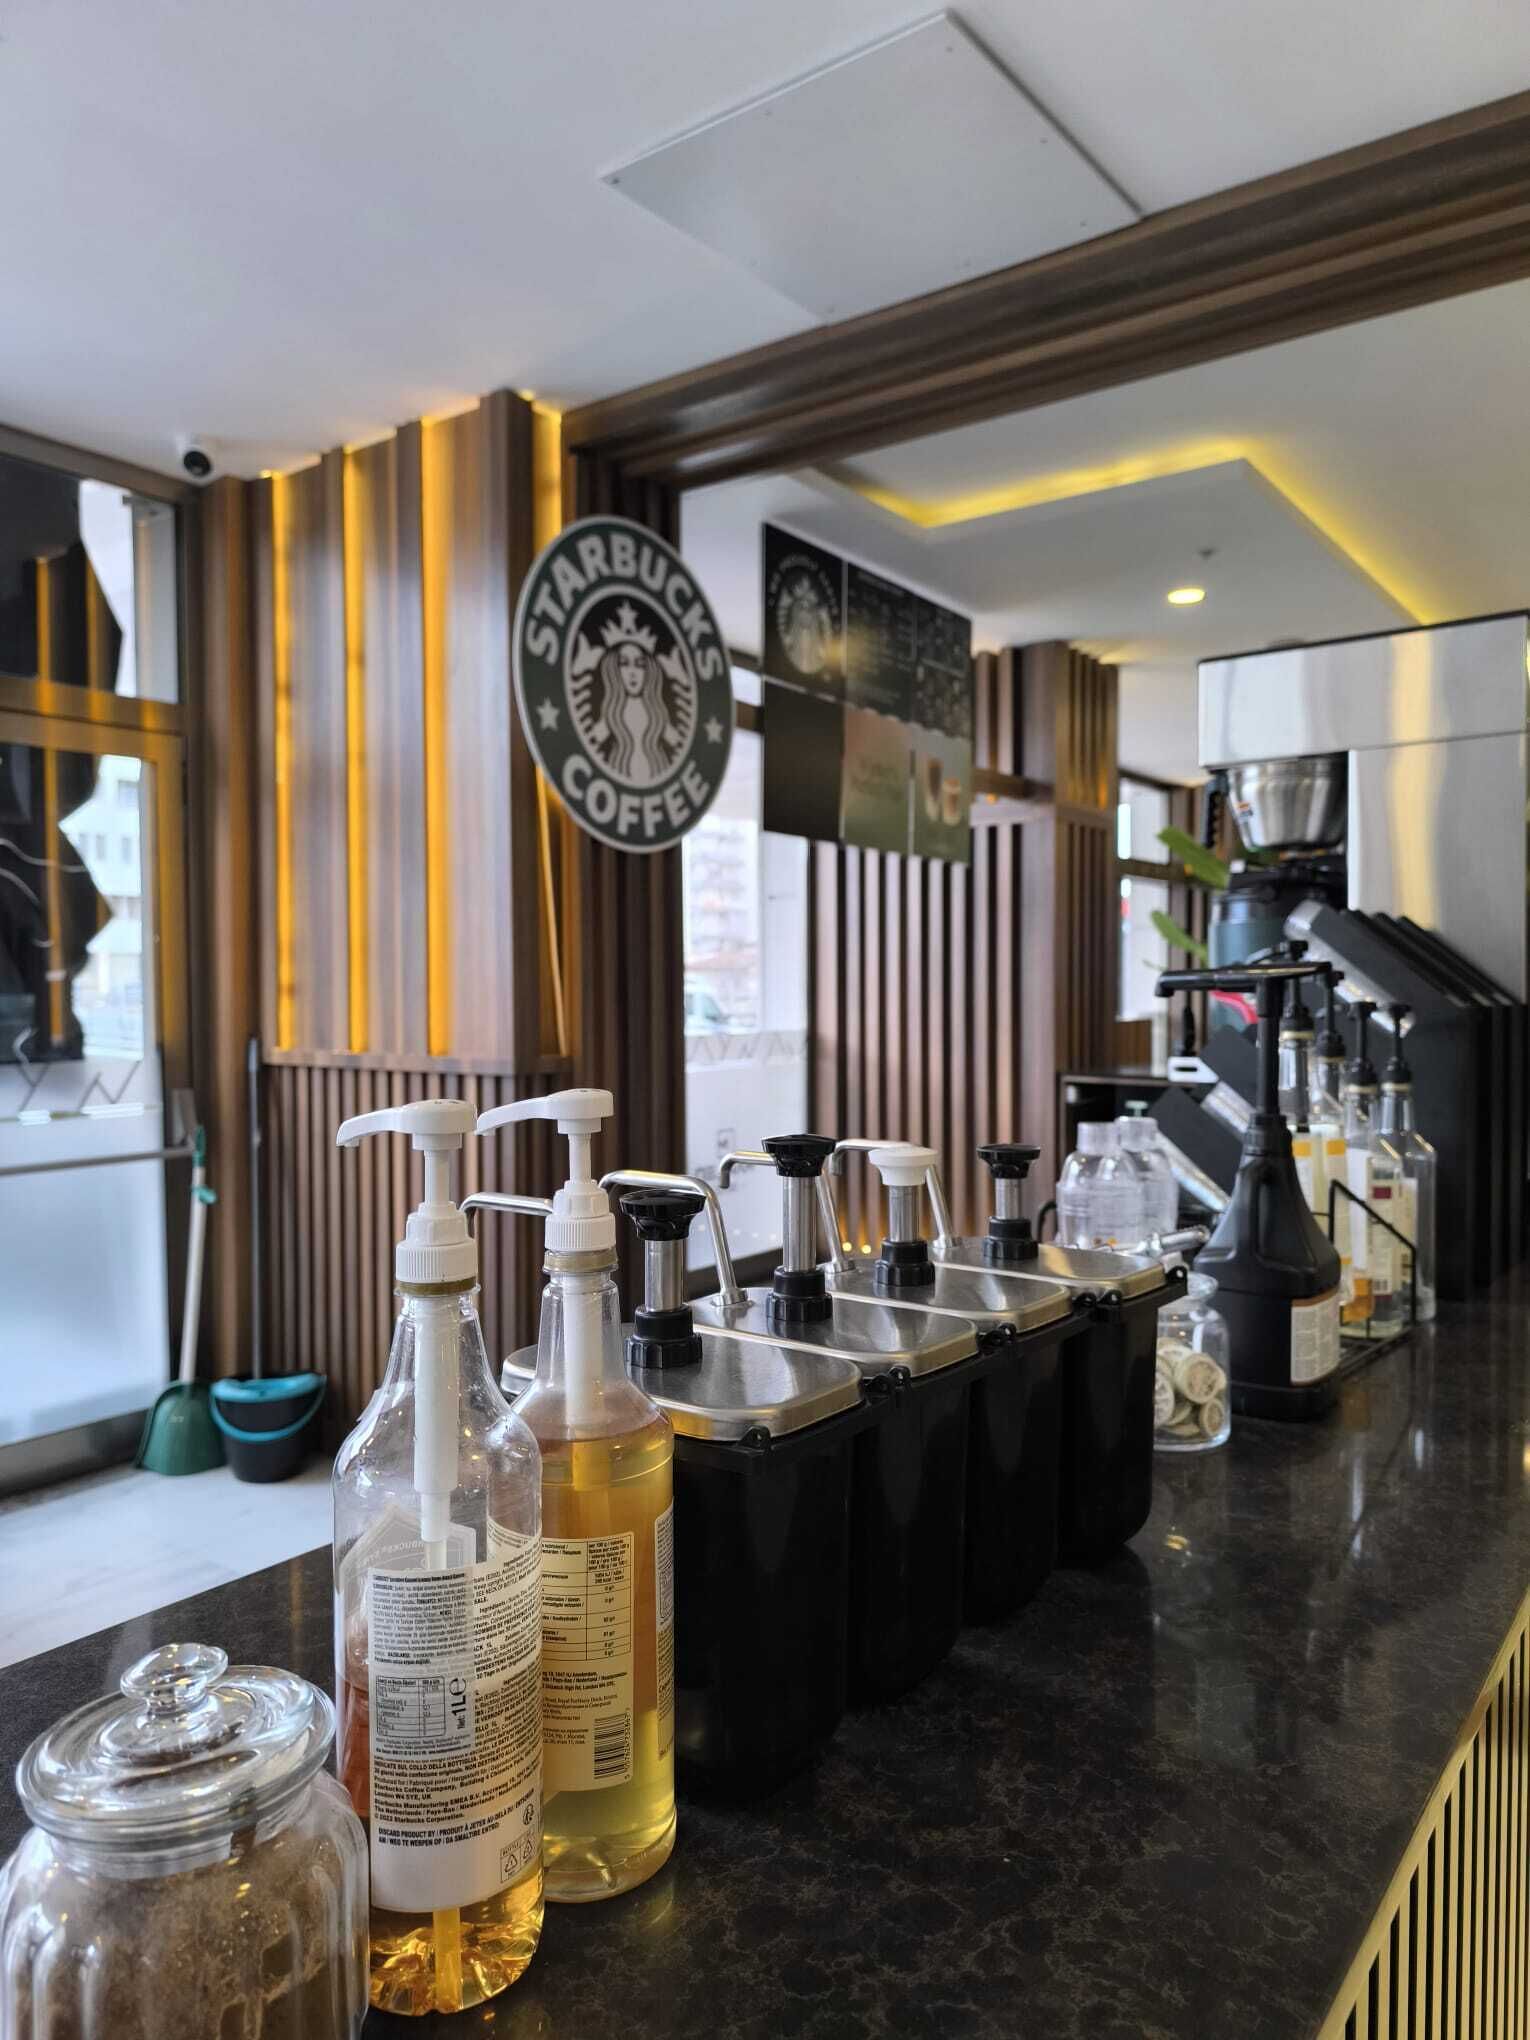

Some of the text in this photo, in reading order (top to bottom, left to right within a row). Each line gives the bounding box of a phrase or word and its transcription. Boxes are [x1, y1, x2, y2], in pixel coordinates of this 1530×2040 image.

[526, 532, 724, 681] STARBUCKS
[562, 753, 711, 838] COFFEE
[379, 1827, 400, 1837] DISCARD
[401, 1829, 426, 1838] PRODUCT
[428, 1829, 435, 1837] BY
[439, 1826, 464, 1836] PRODUIT
